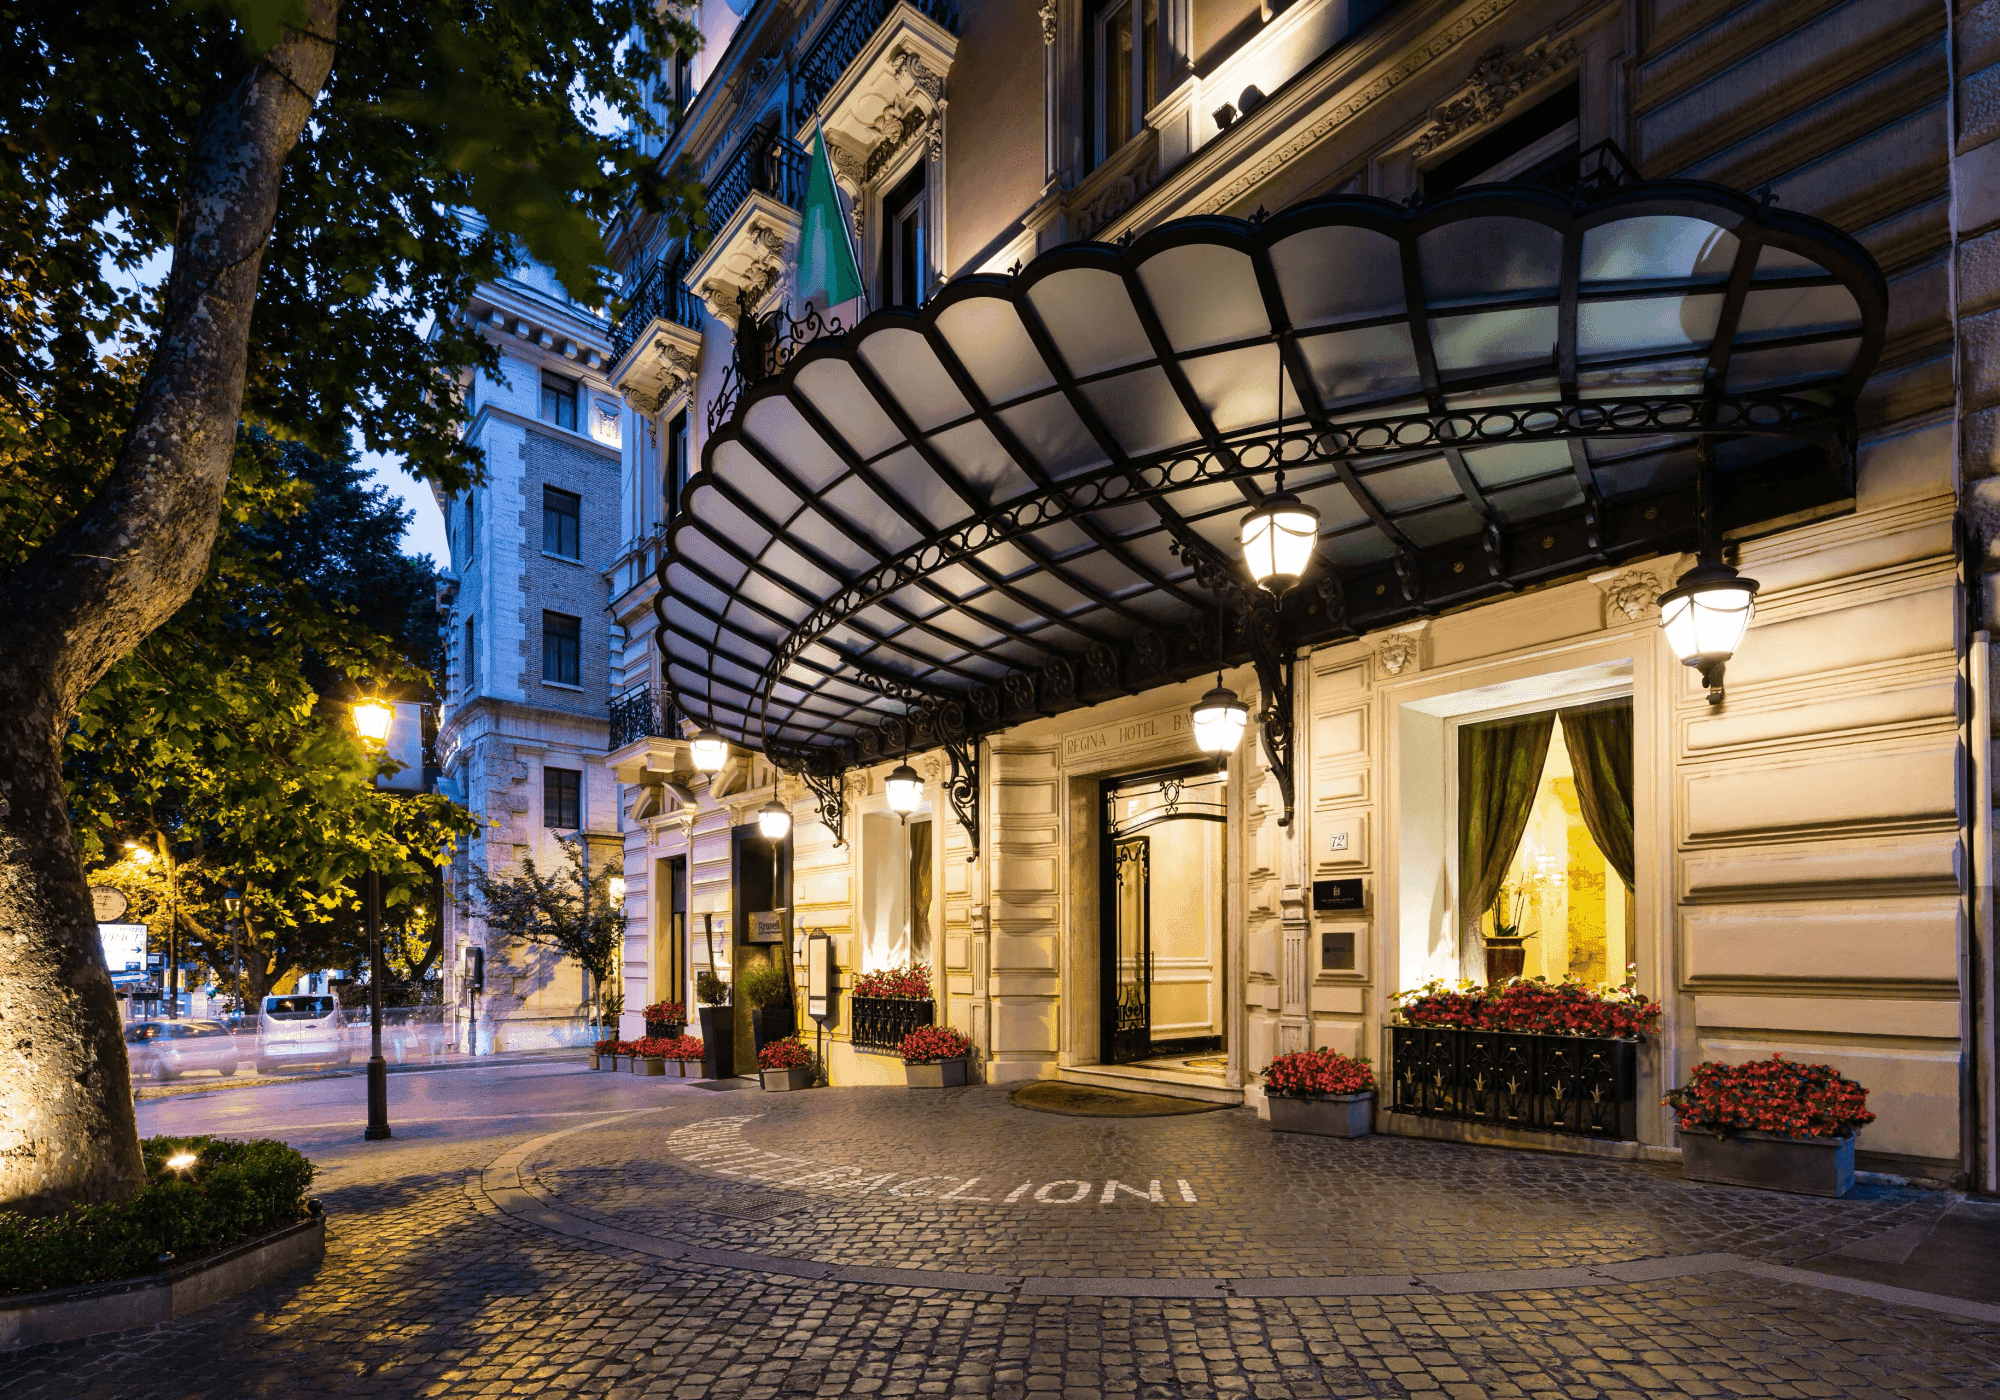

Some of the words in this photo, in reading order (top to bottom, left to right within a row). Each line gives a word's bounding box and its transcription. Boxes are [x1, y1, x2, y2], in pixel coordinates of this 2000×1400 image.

[1067, 733, 1106, 755] REGINA
[1119, 721, 1159, 743] HOTEL
[1332, 835, 1345, 847] 72
[780, 1165, 1198, 1204] BAGLIONI
